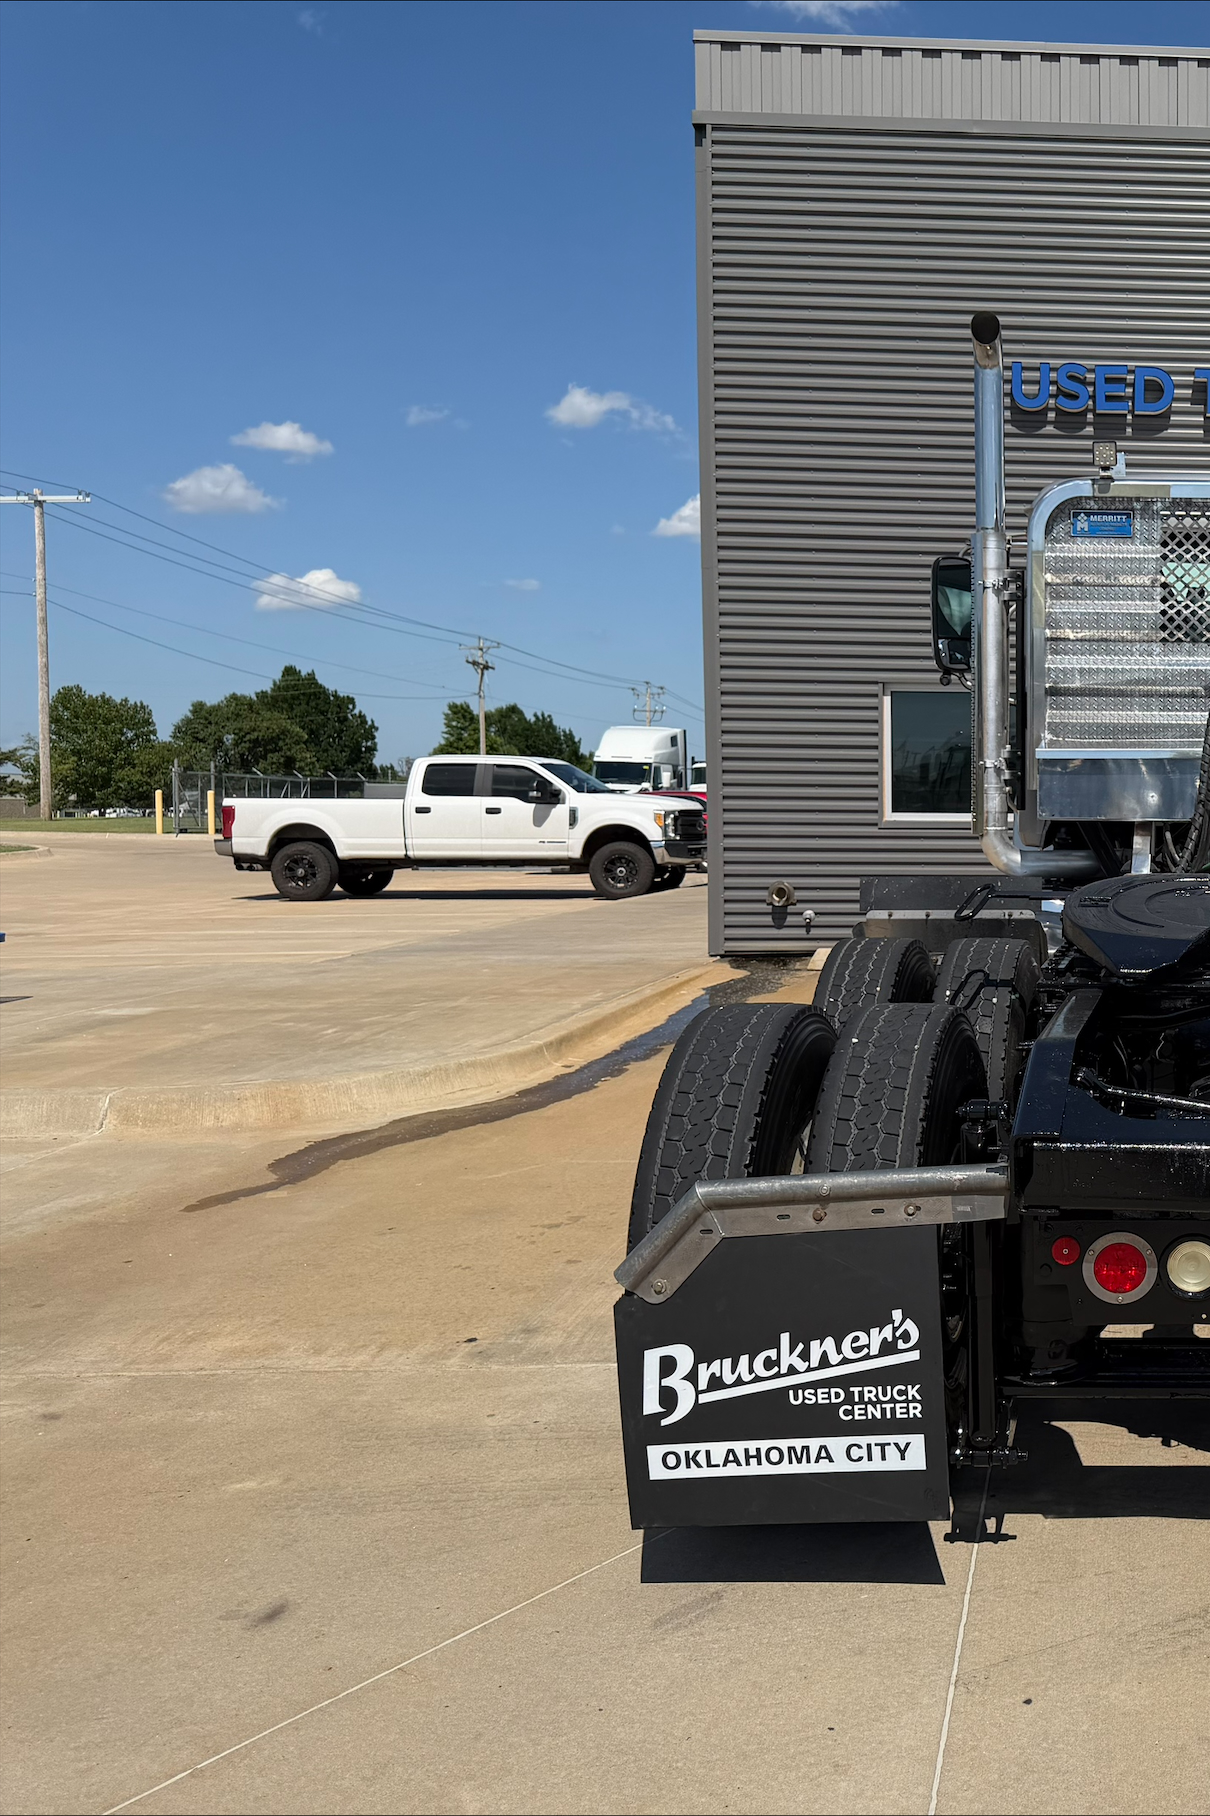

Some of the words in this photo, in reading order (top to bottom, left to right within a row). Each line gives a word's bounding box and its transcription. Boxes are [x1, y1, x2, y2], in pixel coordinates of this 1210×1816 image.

[1011, 361, 1174, 416] USED
[642, 1308, 921, 1427] Bruckner's
[788, 1386, 846, 1406] USED
[849, 1384, 923, 1403] TRUCK
[838, 1402, 923, 1421] CENTER
[660, 1443, 835, 1471] OKLAHOMA
[844, 1441, 912, 1464] CITY
